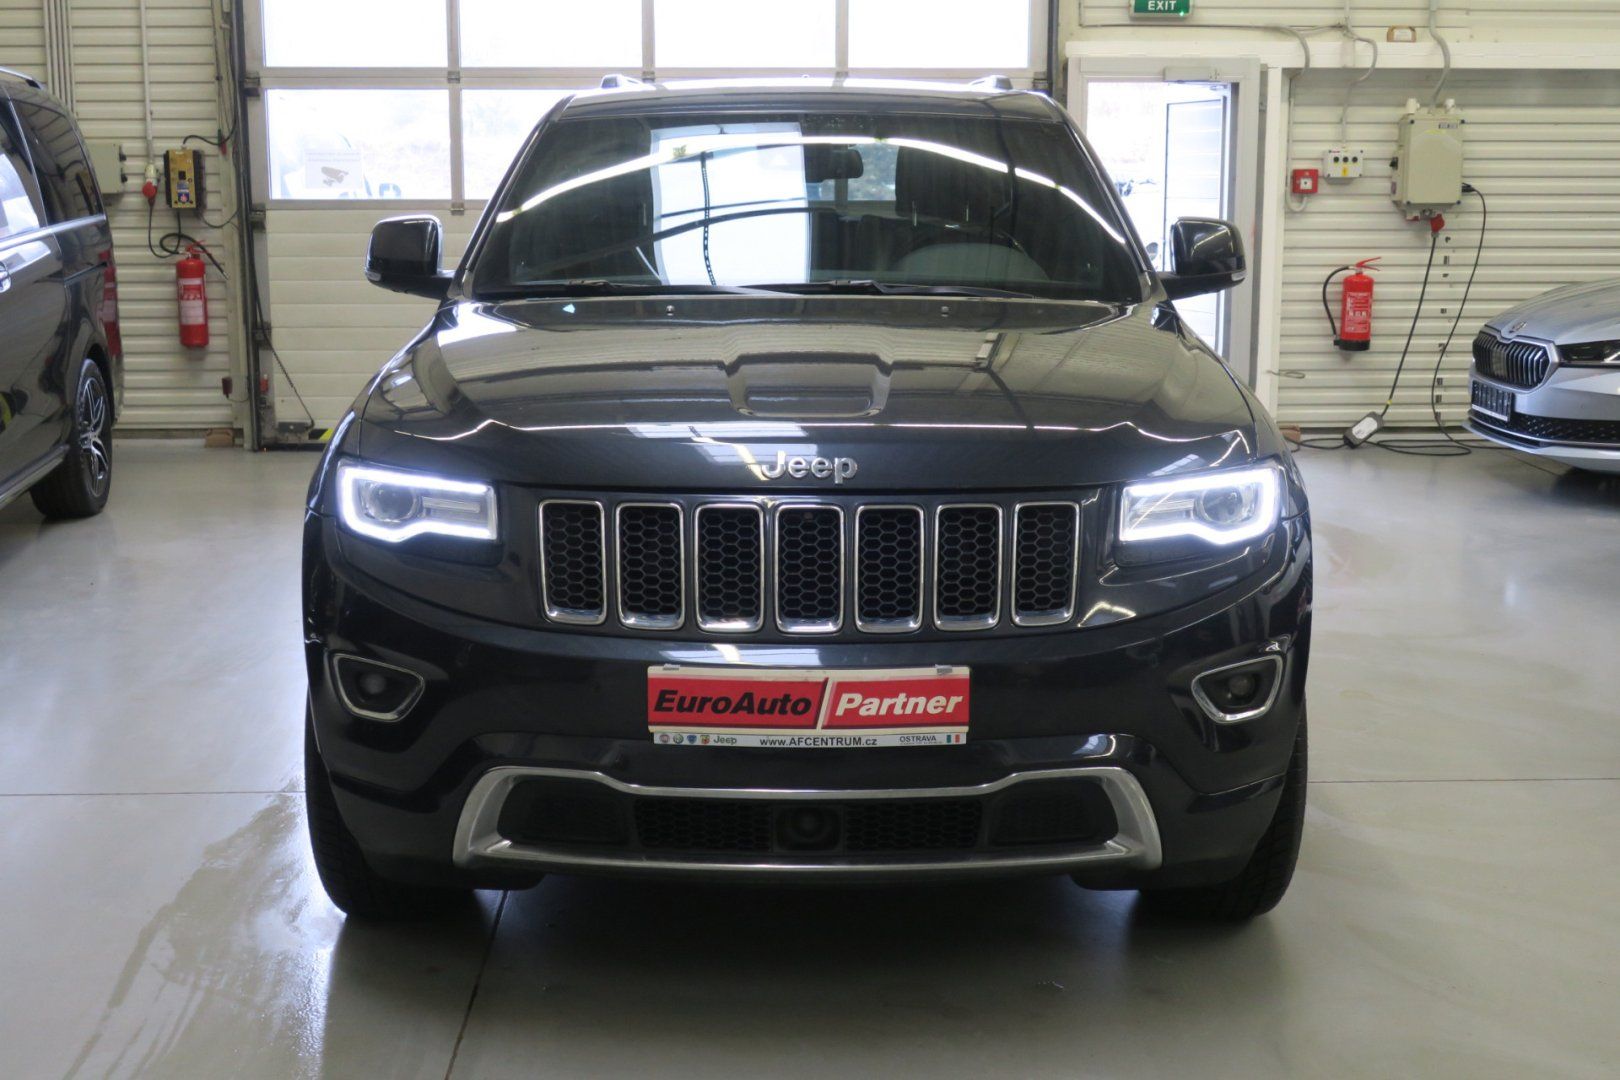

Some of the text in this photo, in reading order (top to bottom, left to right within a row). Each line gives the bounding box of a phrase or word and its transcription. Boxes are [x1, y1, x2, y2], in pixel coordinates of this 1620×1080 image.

[1147, 0, 1177, 11] EXIT
[761, 450, 858, 485] Jeep
[654, 689, 963, 716] EuroAuto Partner
[713, 735, 738, 746] Jeep
[759, 736, 878, 747] www.AFCENTRUM.cz
[899, 735, 937, 743] OSTRAVA
